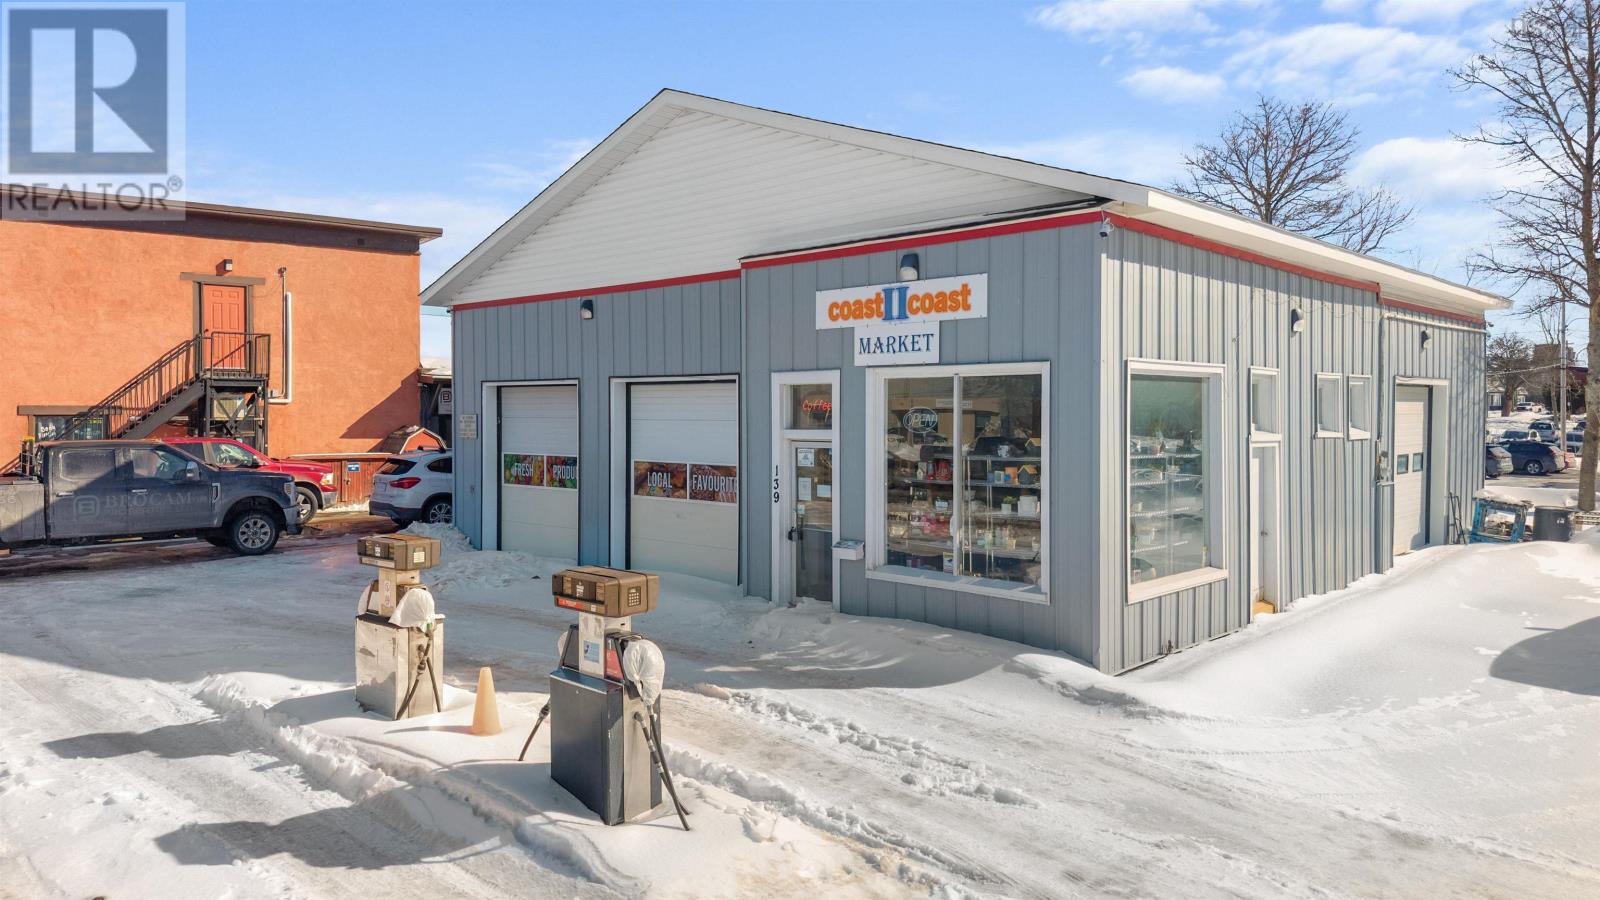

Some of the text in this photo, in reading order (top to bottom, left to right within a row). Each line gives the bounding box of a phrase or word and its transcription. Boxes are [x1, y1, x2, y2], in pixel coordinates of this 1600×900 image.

[859, 333, 934, 355] MARKET
[802, 399, 832, 411] Coffee
[905, 413, 936, 428] OPEN
[514, 462, 534, 477] FRESH
[647, 471, 672, 488] LOCAL
